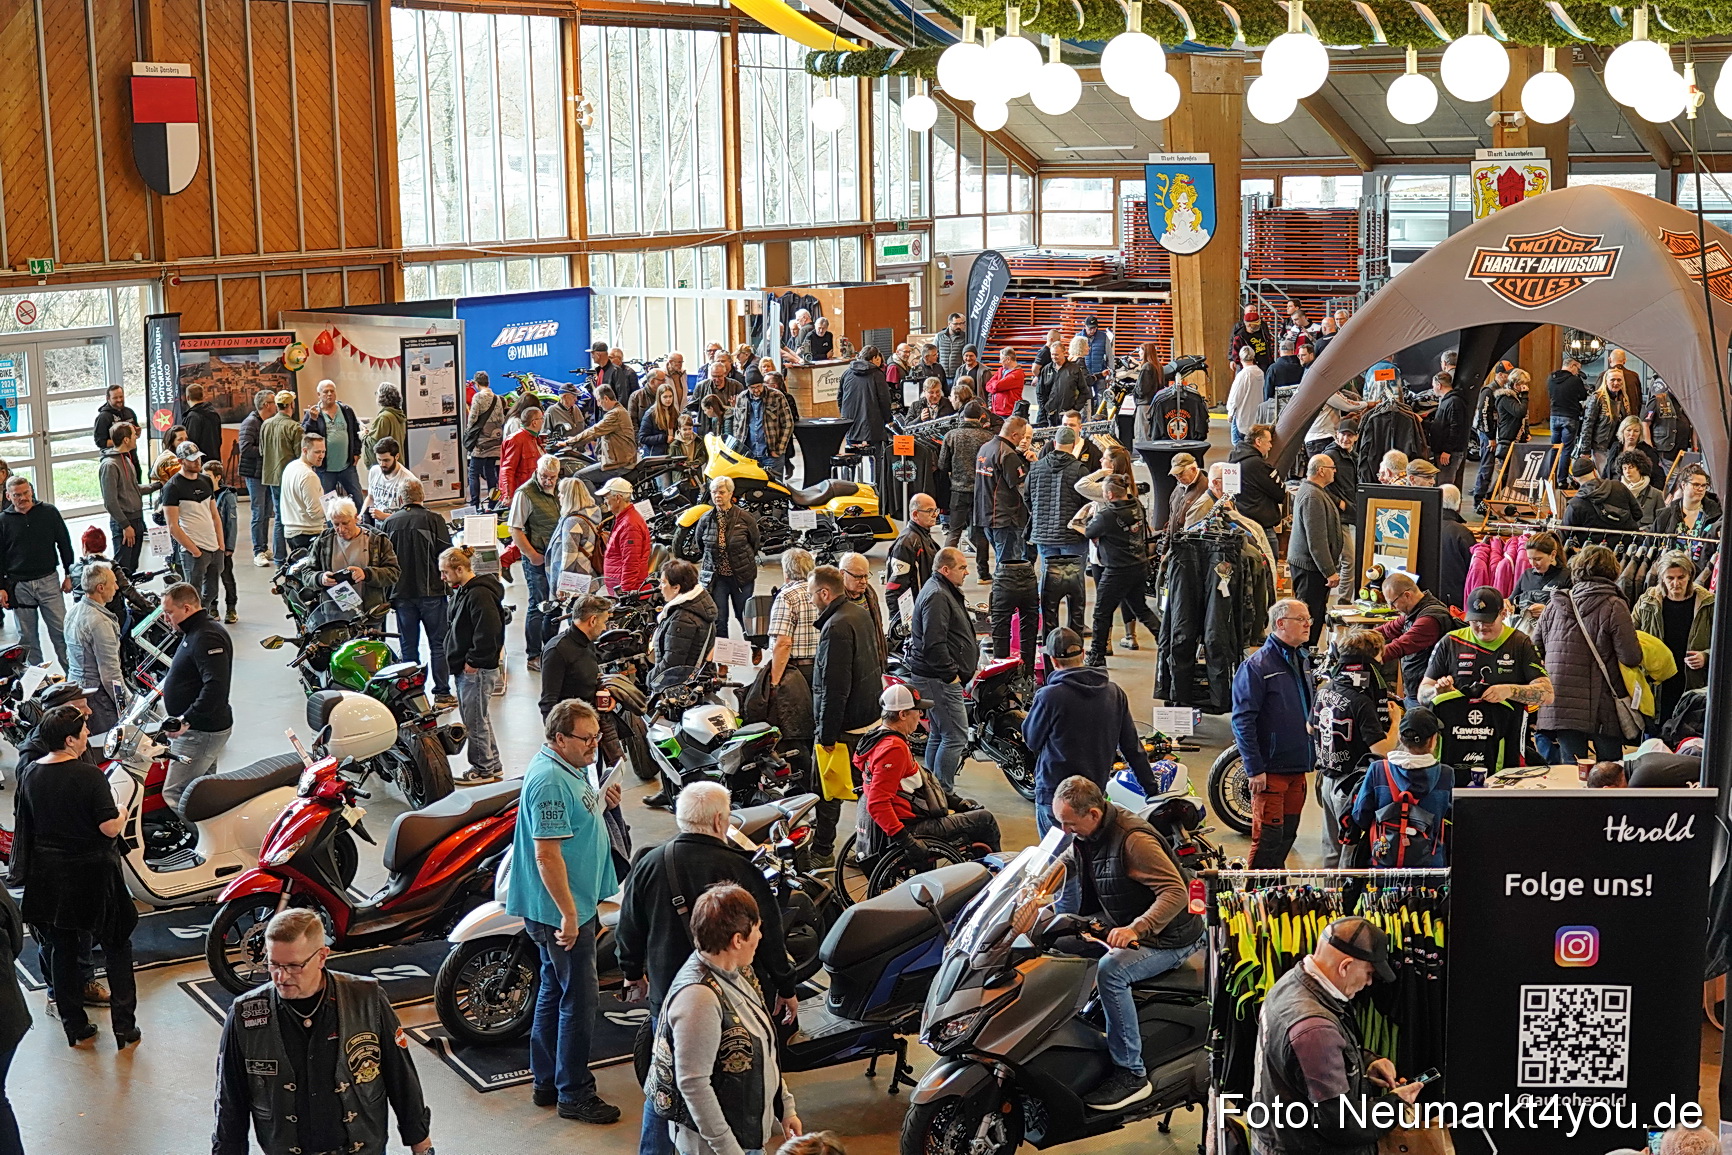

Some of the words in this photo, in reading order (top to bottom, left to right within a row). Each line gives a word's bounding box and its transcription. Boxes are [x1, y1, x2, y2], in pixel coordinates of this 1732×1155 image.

[1518, 236, 1584, 252] MOTOR
[1480, 255, 1608, 273] HARLEY-DAVIDSON
[970, 270, 994, 320] TRIUMPH
[1504, 278, 1571, 300] CYCLES
[980, 294, 1000, 338] NÜRNBERG
[180, 338, 240, 348] ASZINATION
[246, 336, 291, 346] MAROKKO
[491, 322, 559, 348] MEYER
[516, 342, 548, 359] YAMAHA
[164, 363, 174, 404] MAROKKO
[1462, 752, 1484, 763] Ninja
[541, 810, 564, 820] 1967
[1603, 812, 1695, 842] Herold
[1505, 872, 1584, 901] Folge
[1593, 874, 1653, 896] uns!
[1517, 1093, 1626, 1108] @auoherold
